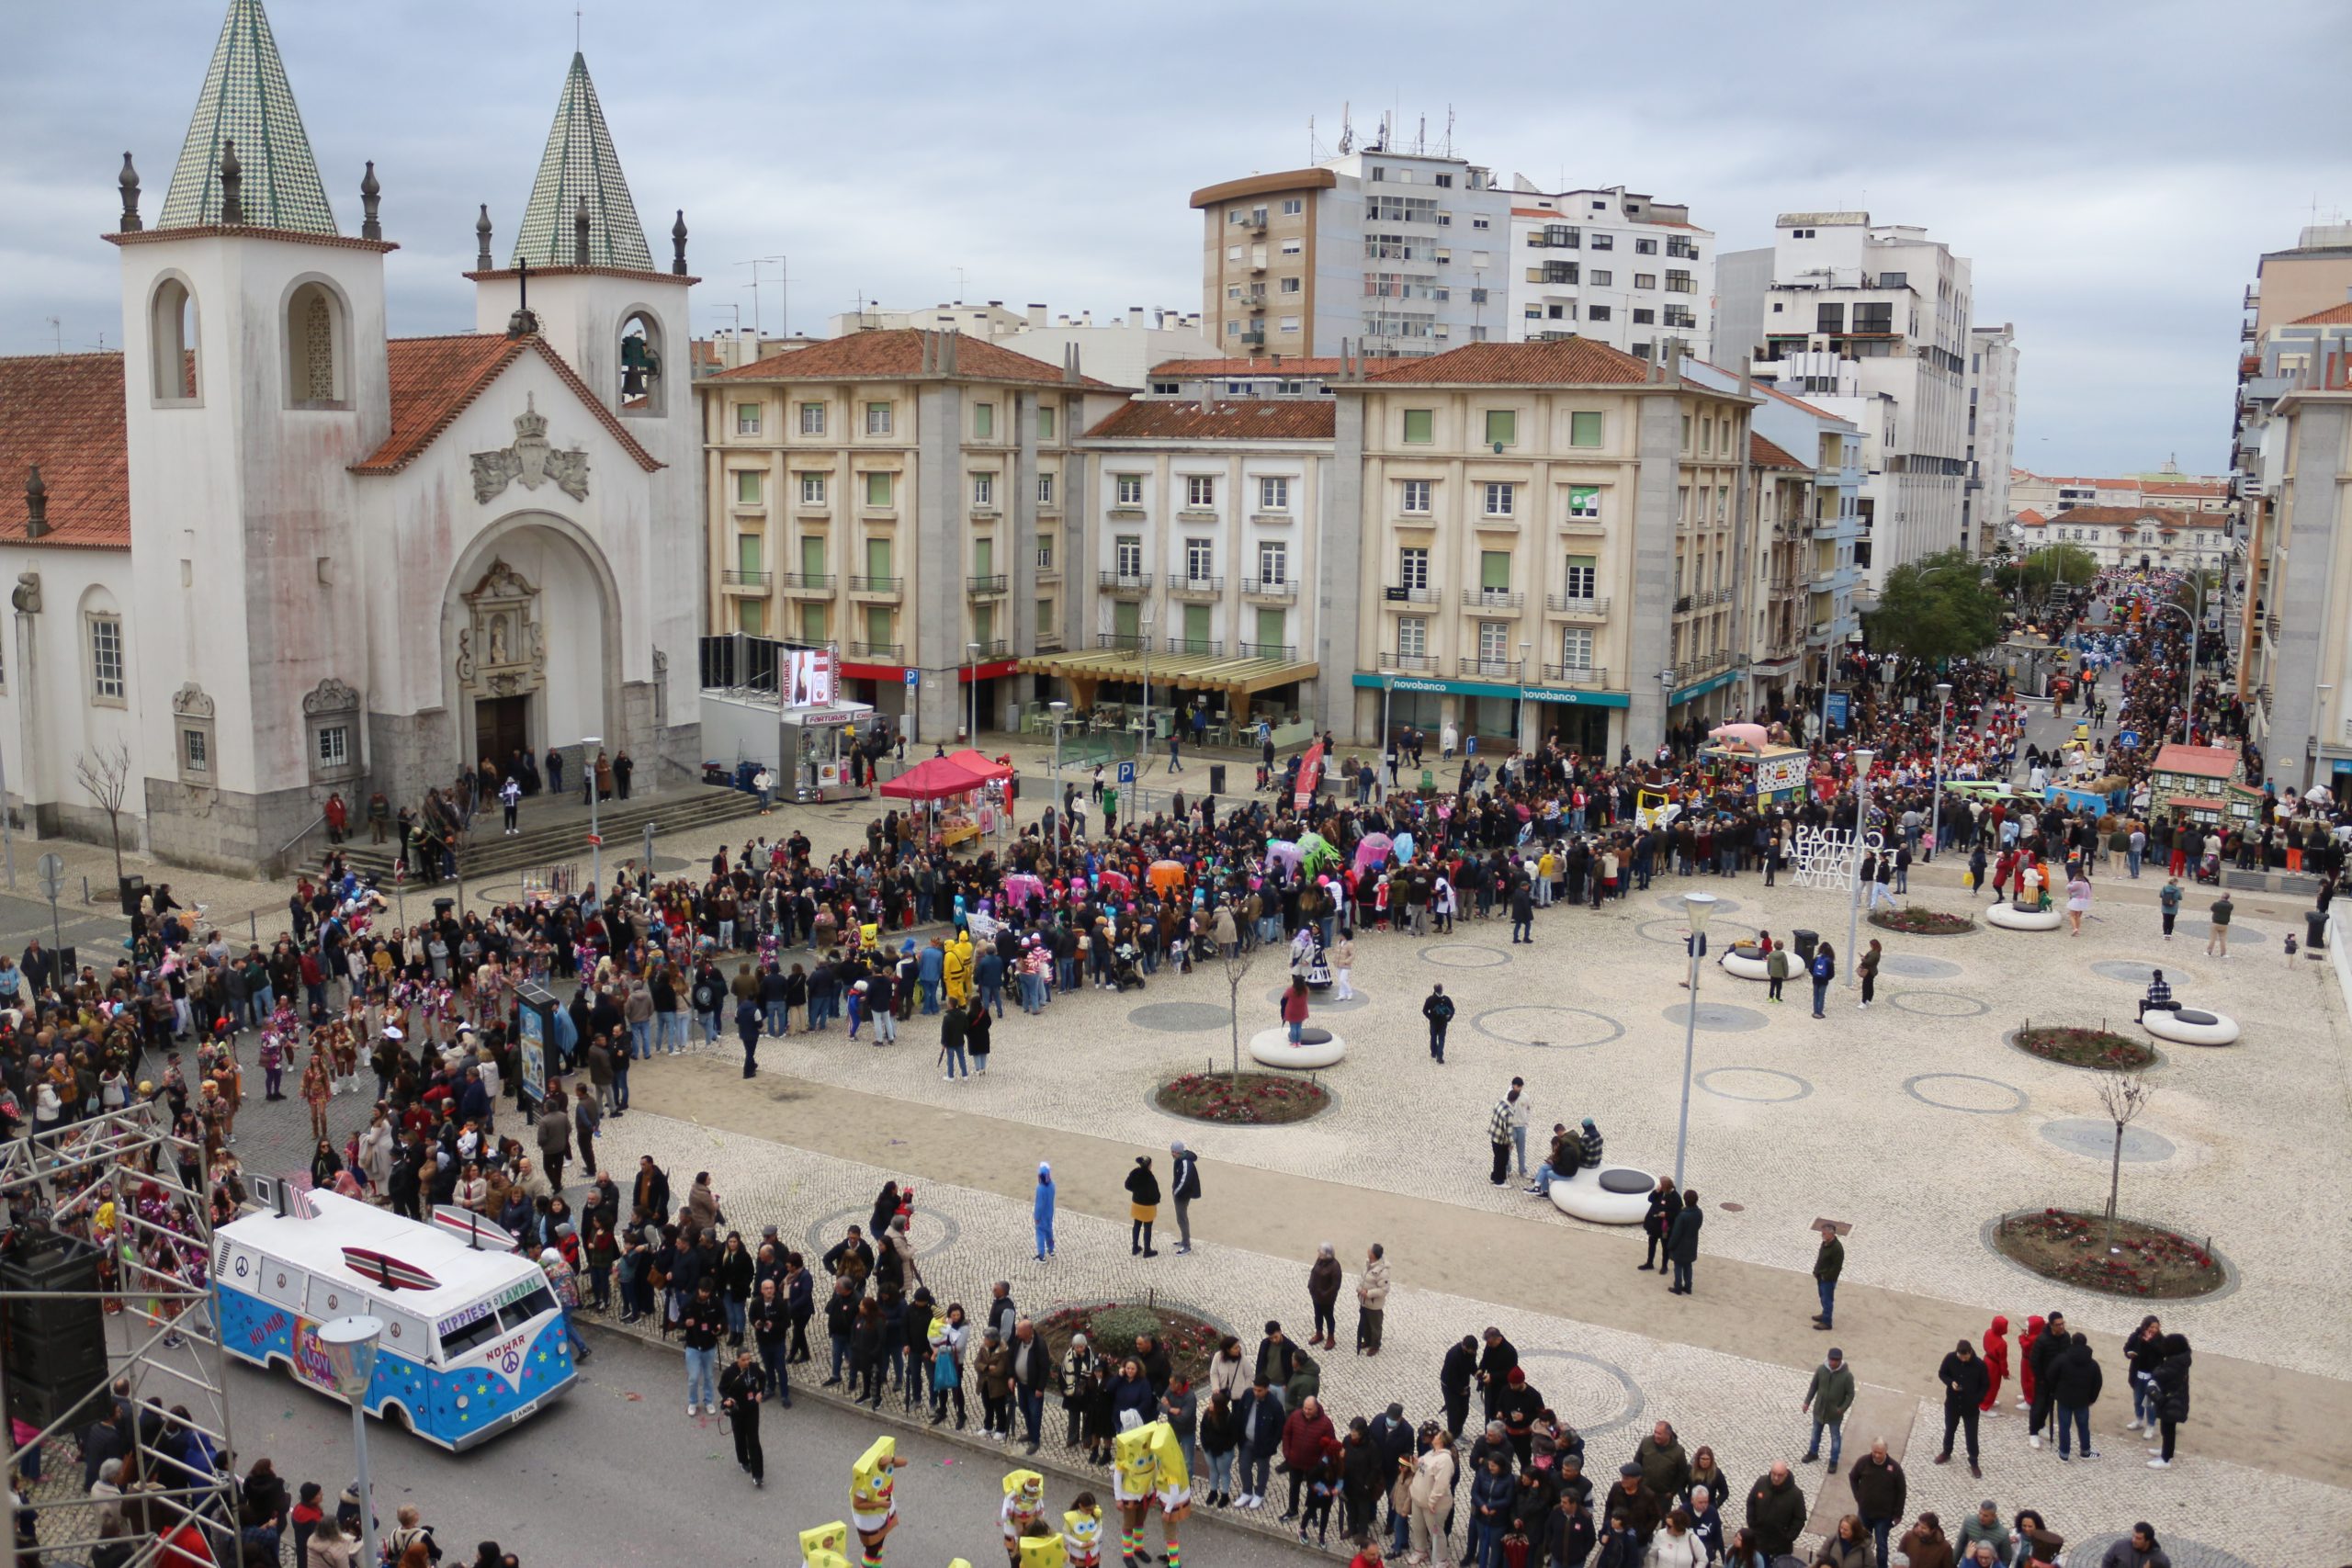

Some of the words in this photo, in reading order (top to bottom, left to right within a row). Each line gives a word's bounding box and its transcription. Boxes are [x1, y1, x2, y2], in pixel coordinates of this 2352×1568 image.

[907, 671, 914, 682] P
[1394, 681, 1446, 692] novobanco
[1522, 690, 1577, 702] novobanco
[1121, 764, 1130, 781] P
[437, 1303, 486, 1335] HIPPIES
[499, 1278, 541, 1306] LANDAL
[249, 1325, 265, 1347] NO
[262, 1312, 288, 1337] WAR
[300, 1329, 327, 1357] PEA
[485, 1347, 502, 1362] NO
[502, 1334, 526, 1354] WAR
[305, 1348, 331, 1374] LOV
